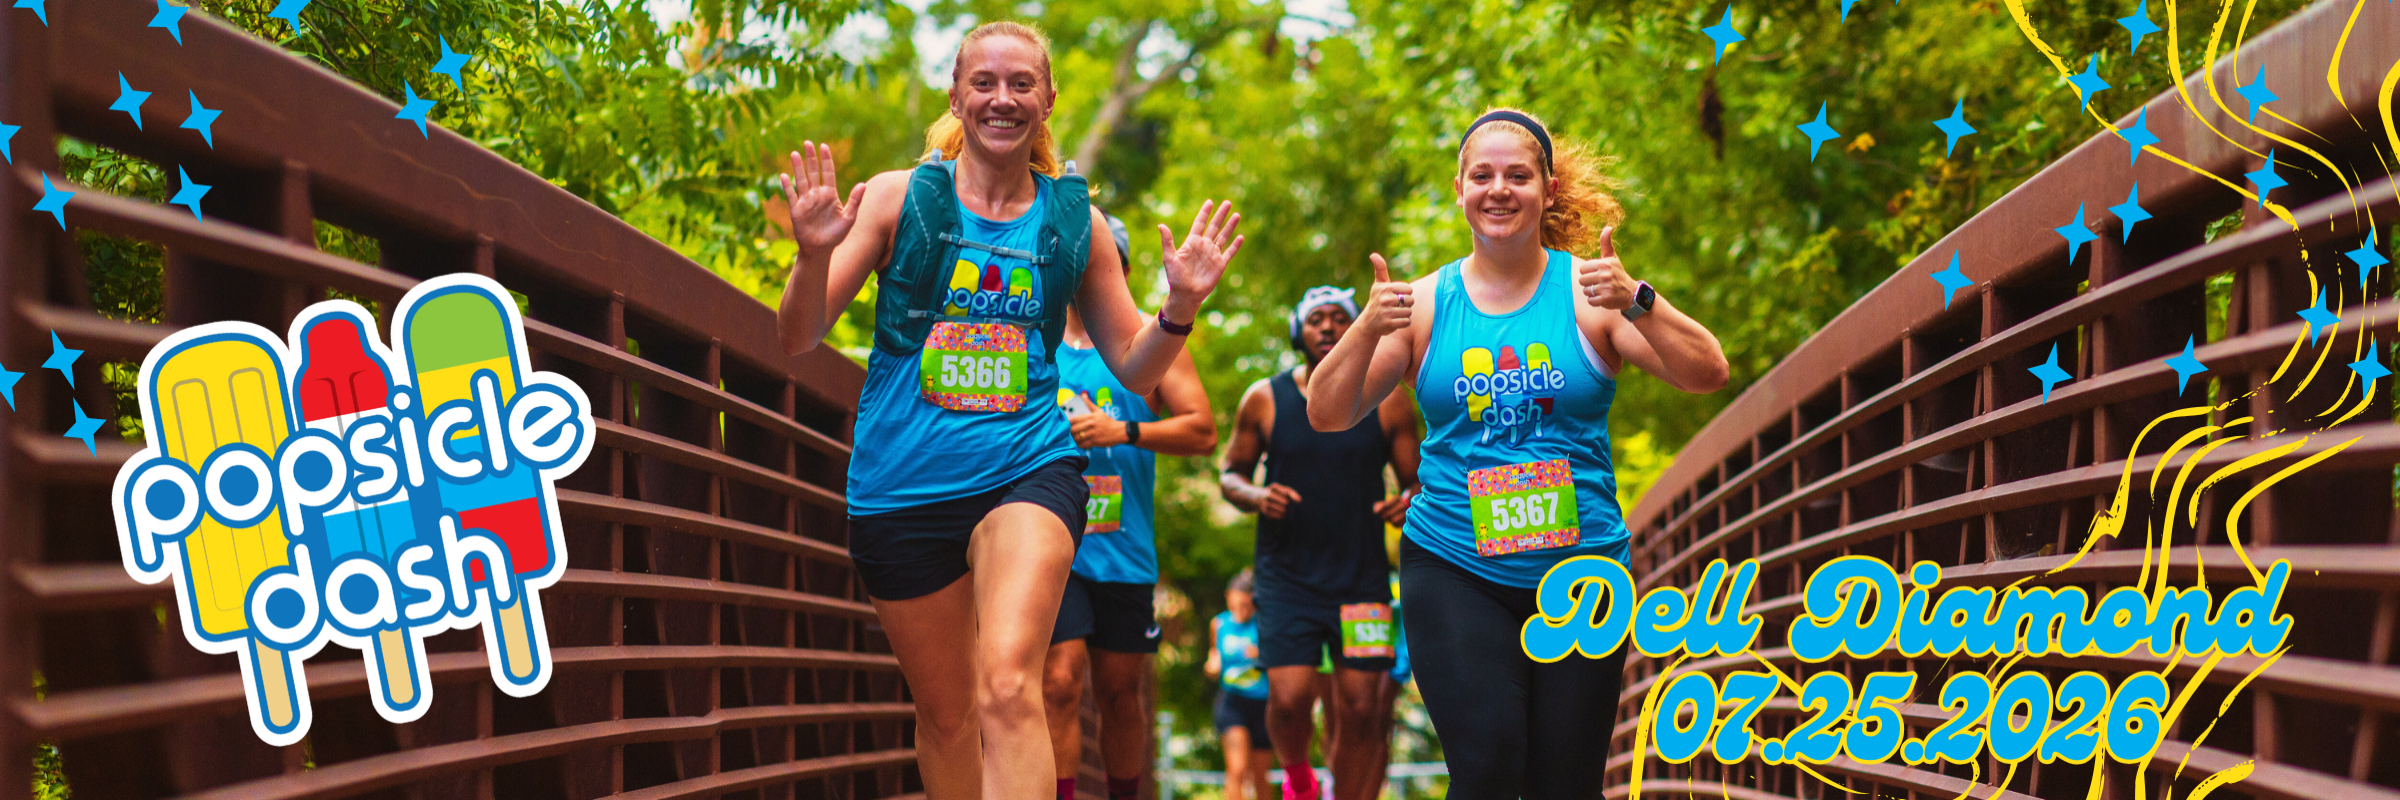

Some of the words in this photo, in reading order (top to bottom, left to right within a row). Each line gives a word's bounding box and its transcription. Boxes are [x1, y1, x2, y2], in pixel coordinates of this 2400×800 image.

[940, 355, 1011, 389] 5366
[1454, 362, 1565, 403] popsicle
[1481, 399, 1542, 427] dash
[1087, 498, 1109, 520] 27
[1490, 491, 1558, 531] 5367
